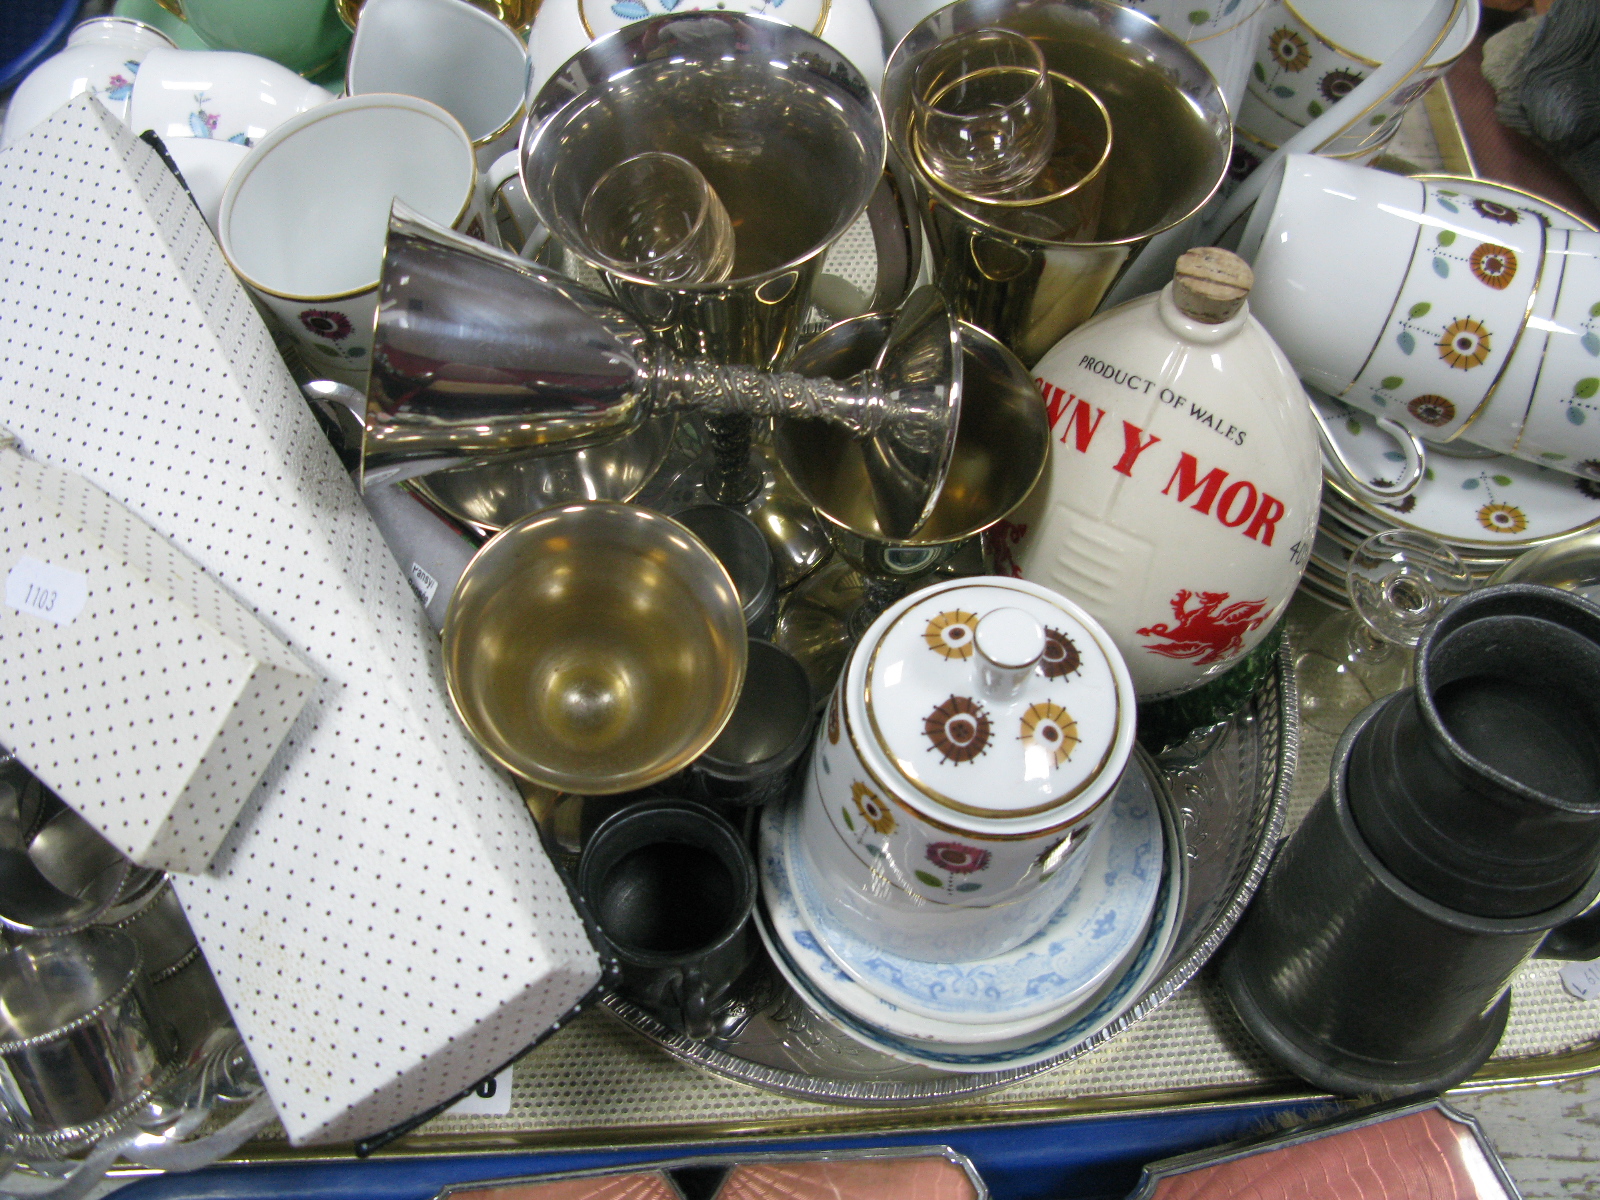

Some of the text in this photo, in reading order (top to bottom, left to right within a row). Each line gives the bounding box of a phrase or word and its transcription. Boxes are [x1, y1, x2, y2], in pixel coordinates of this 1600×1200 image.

[1078, 354, 1247, 446] PRODUCT OF WALES
[1035, 377, 1285, 547] WN Y MOR
[24, 583, 58, 612] 1103
